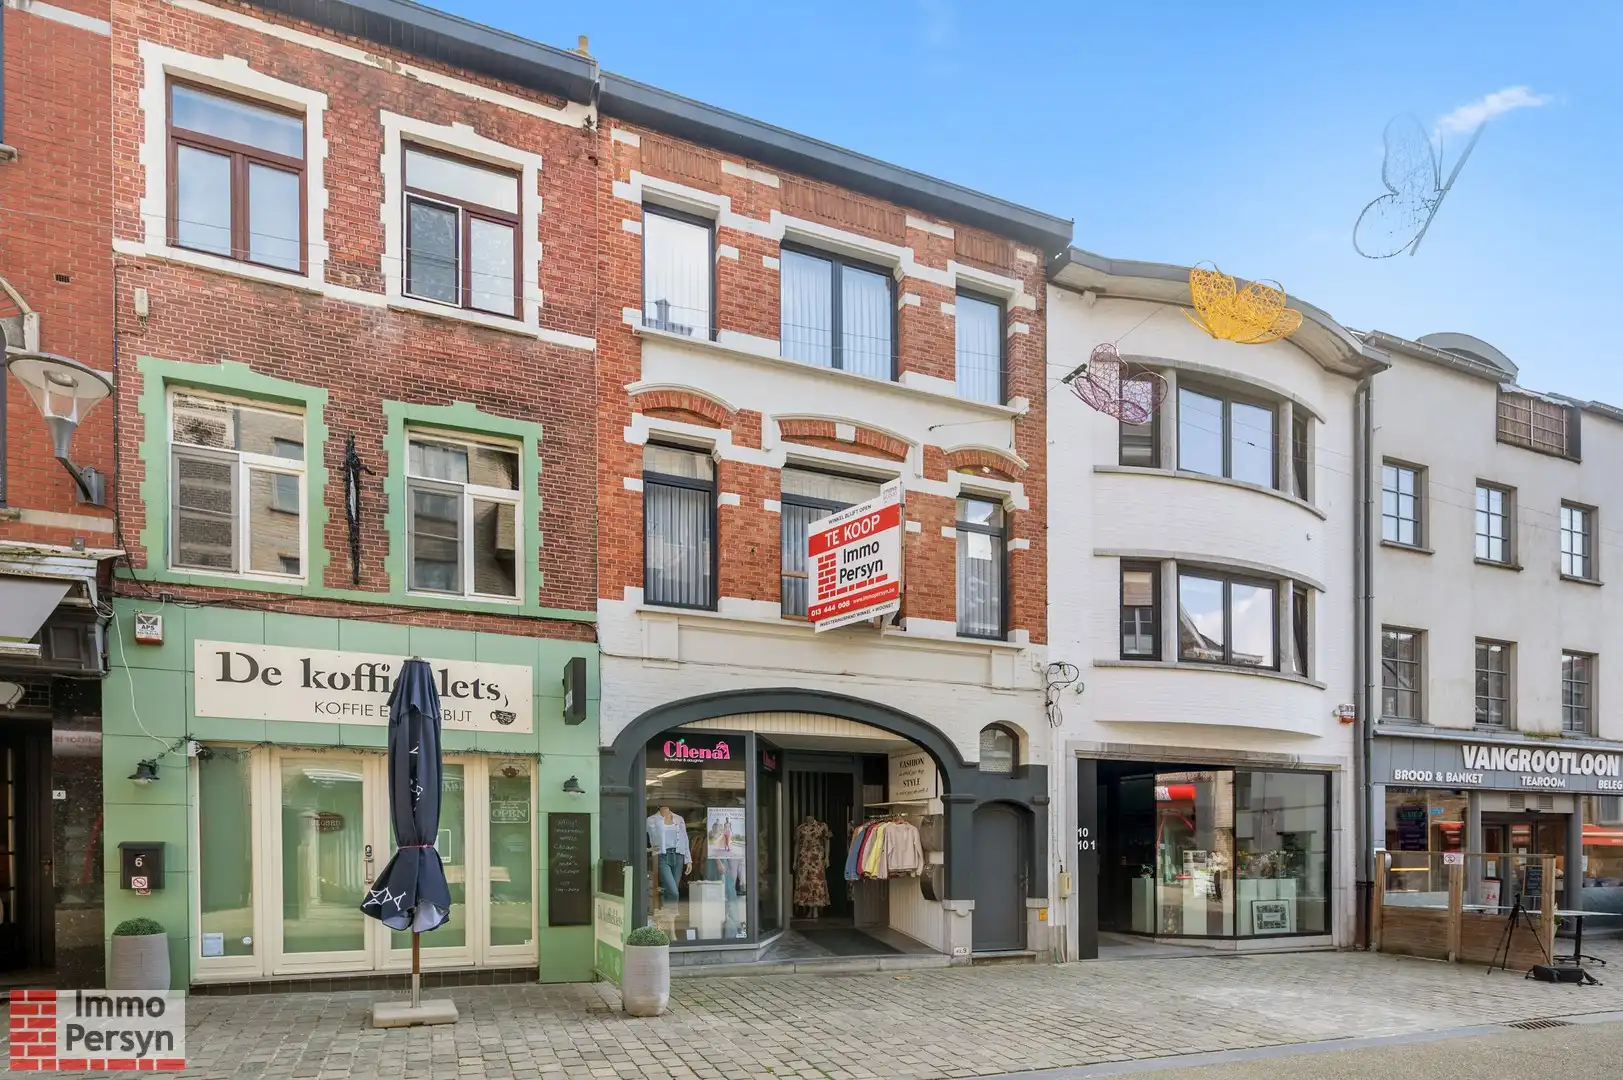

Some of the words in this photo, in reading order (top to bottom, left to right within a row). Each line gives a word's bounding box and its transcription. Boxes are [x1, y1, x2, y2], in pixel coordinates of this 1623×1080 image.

[828, 514, 844, 524] WINKEL
[859, 504, 872, 513] OPEN
[825, 529, 840, 548] TE
[844, 514, 880, 541] KOOP
[843, 541, 880, 564] Immo
[840, 559, 883, 584] Persyn
[811, 608, 822, 617] 013
[823, 604, 836, 613] 444
[853, 588, 895, 604] www.immopersyn.be
[215, 651, 283, 686] De
[314, 701, 374, 717] KOFFIE
[379, 705, 389, 718] E
[899, 756, 925, 769] FASHION
[1461, 745, 1620, 777] VANGROOTLOON
[902, 777, 921, 788] STYLE
[1394, 769, 1433, 782] BROOD
[1435, 771, 1443, 783] &
[1445, 772, 1484, 784] BANKET
[1521, 775, 1566, 788] TEAROOM
[1598, 779, 1623, 790] BELEG
[492, 809, 527, 818] OPEN
[1077, 827, 1089, 838] 10
[1077, 840, 1089, 850] 10
[134, 857, 143, 867] 6
